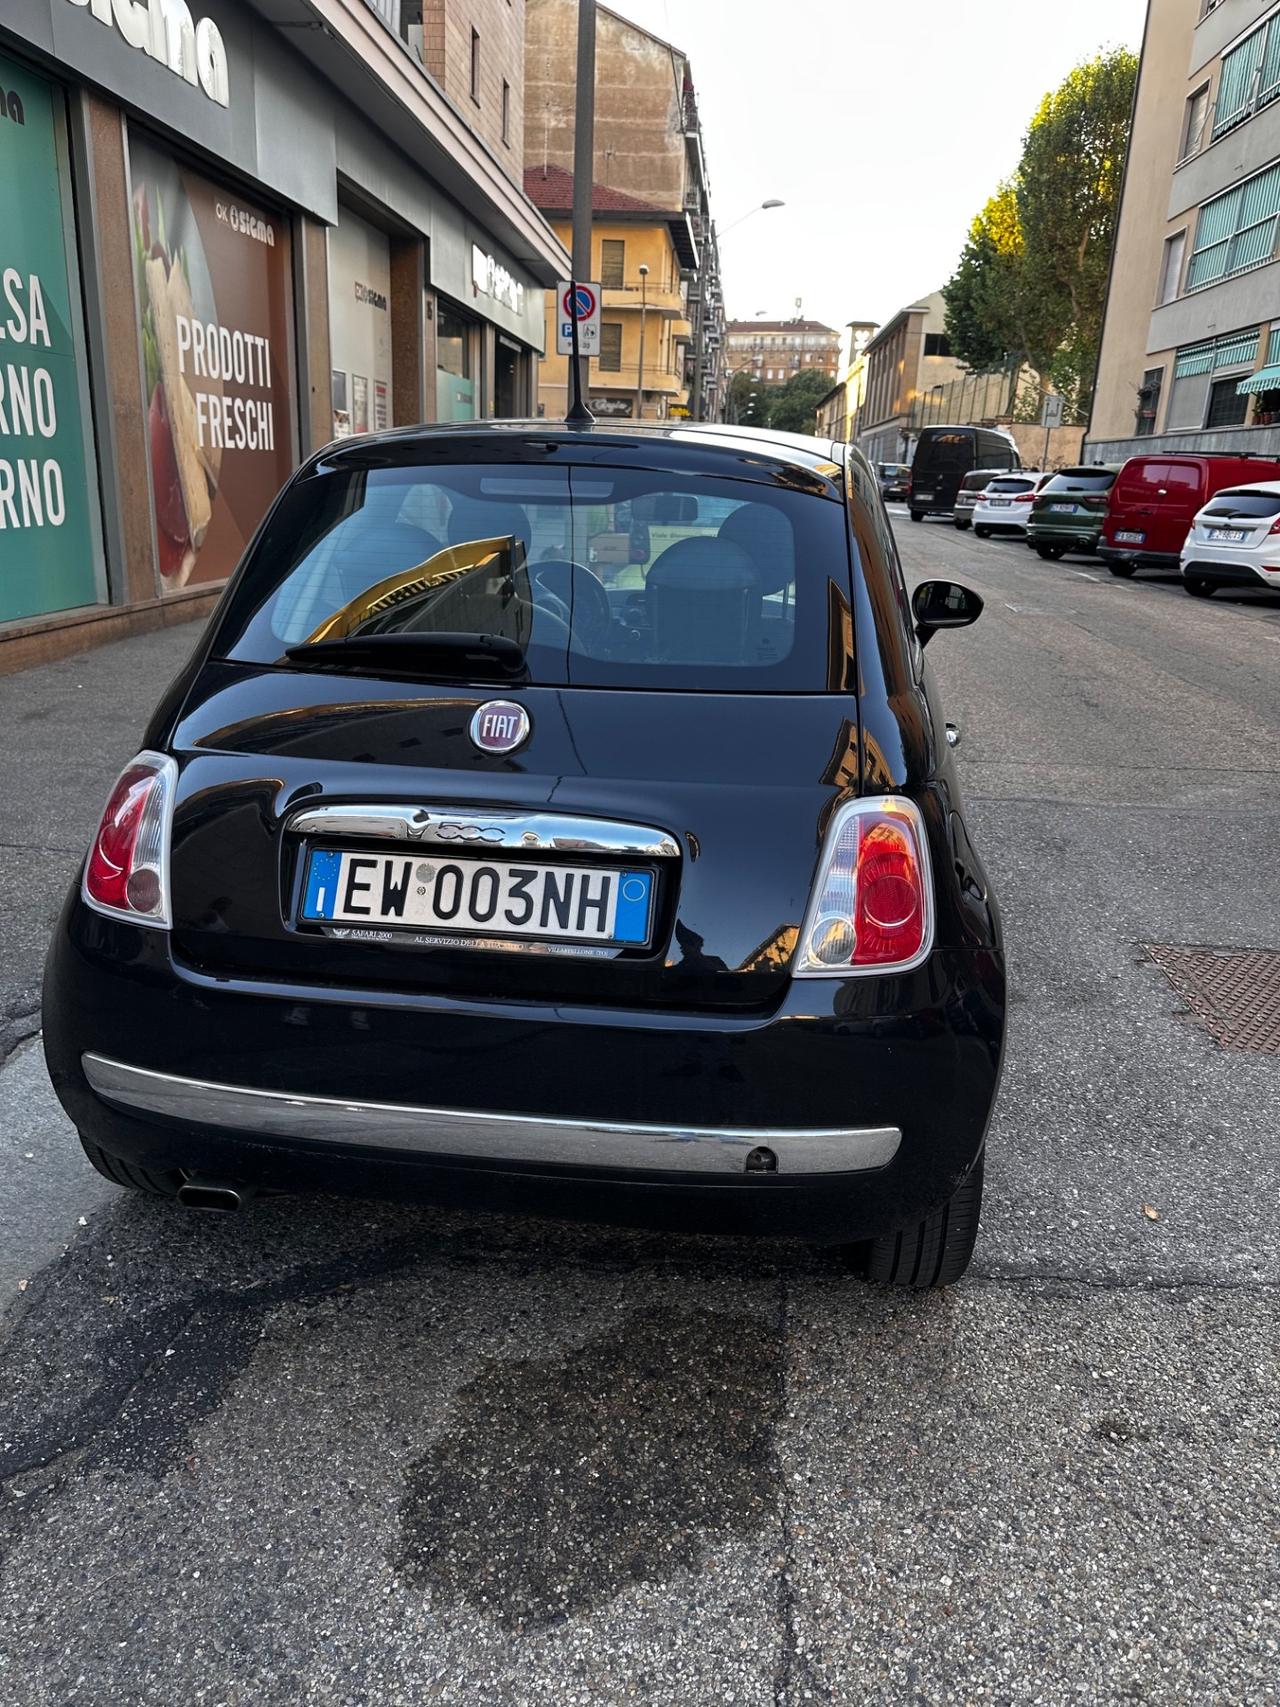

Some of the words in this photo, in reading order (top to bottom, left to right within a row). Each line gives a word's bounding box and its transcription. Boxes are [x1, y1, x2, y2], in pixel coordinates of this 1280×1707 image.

[239, 211, 275, 247] sigma
[0, 268, 51, 347] SA
[176, 314, 272, 389] PRODOTTI
[195, 392, 274, 451] FRESCHI
[482, 714, 519, 739] FIAT
[343, 858, 413, 917] EW
[351, 929, 377, 938] SAFARI
[425, 937, 459, 946] SERVIZIO
